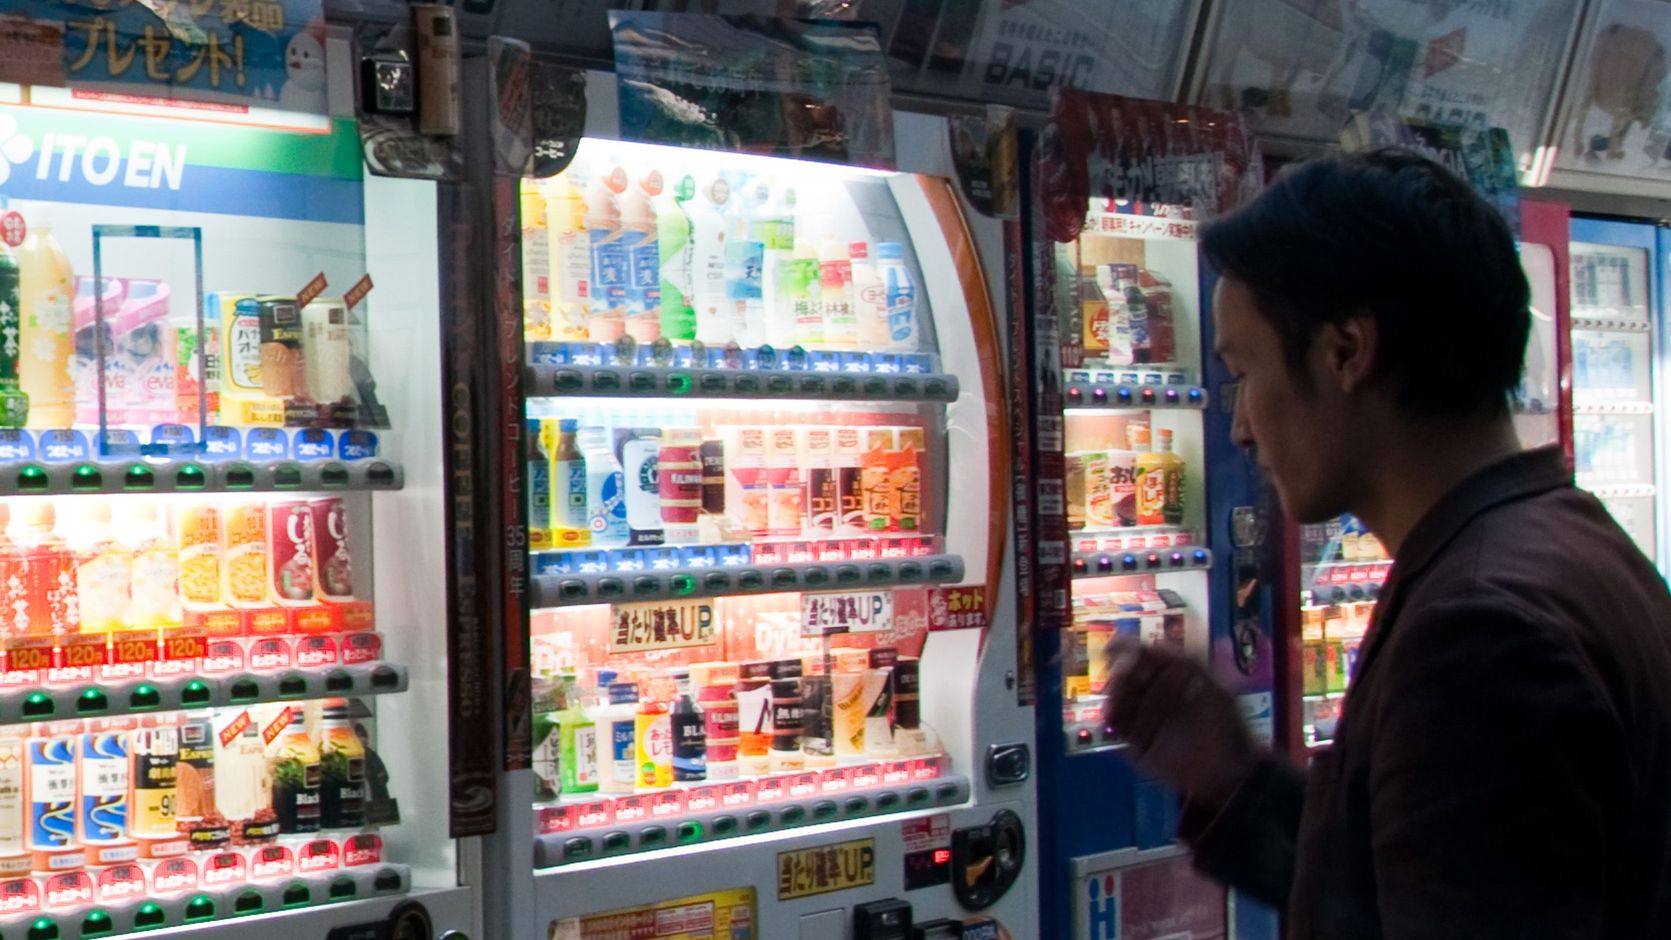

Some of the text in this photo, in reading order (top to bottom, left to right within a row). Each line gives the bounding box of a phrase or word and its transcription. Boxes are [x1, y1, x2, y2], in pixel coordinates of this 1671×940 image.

[36, 133, 188, 190] ITO EN
[222, 714, 249, 742] NEW
[266, 710, 292, 740] NEW
